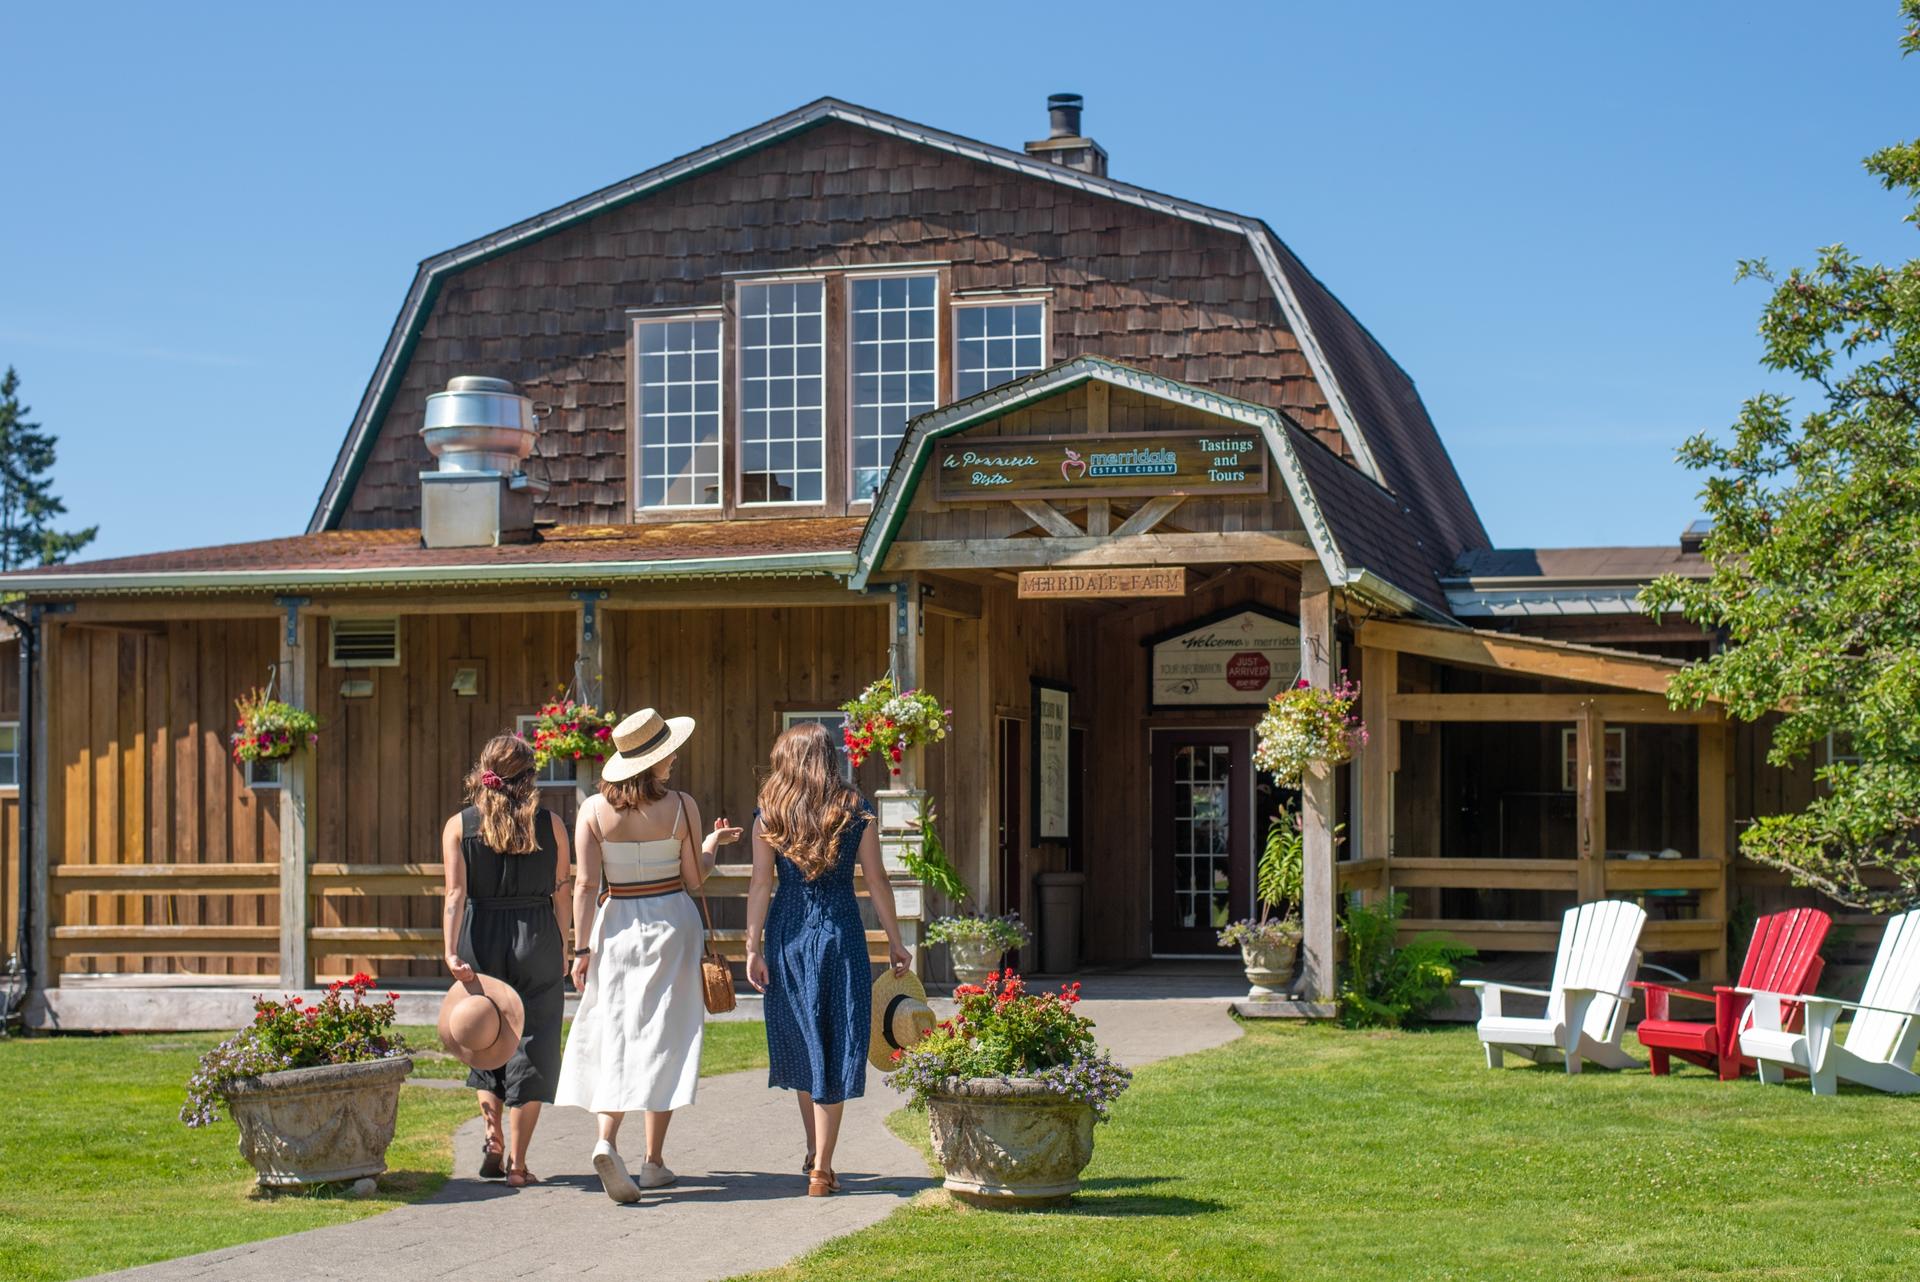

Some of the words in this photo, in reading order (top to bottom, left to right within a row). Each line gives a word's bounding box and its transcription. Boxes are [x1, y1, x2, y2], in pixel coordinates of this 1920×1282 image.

[1199, 439, 1253, 453] Tastings
[1090, 448, 1177, 465] merridale
[1213, 454, 1238, 466] and
[1092, 465, 1130, 474] ESTATE
[1135, 464, 1173, 473] CIDERY
[1207, 469, 1245, 482] Tours
[1023, 575, 1118, 593] MERRIDALE
[1131, 574, 1179, 590] FARM
[1182, 634, 1243, 649] Welcome
[1236, 656, 1258, 667] JUST
